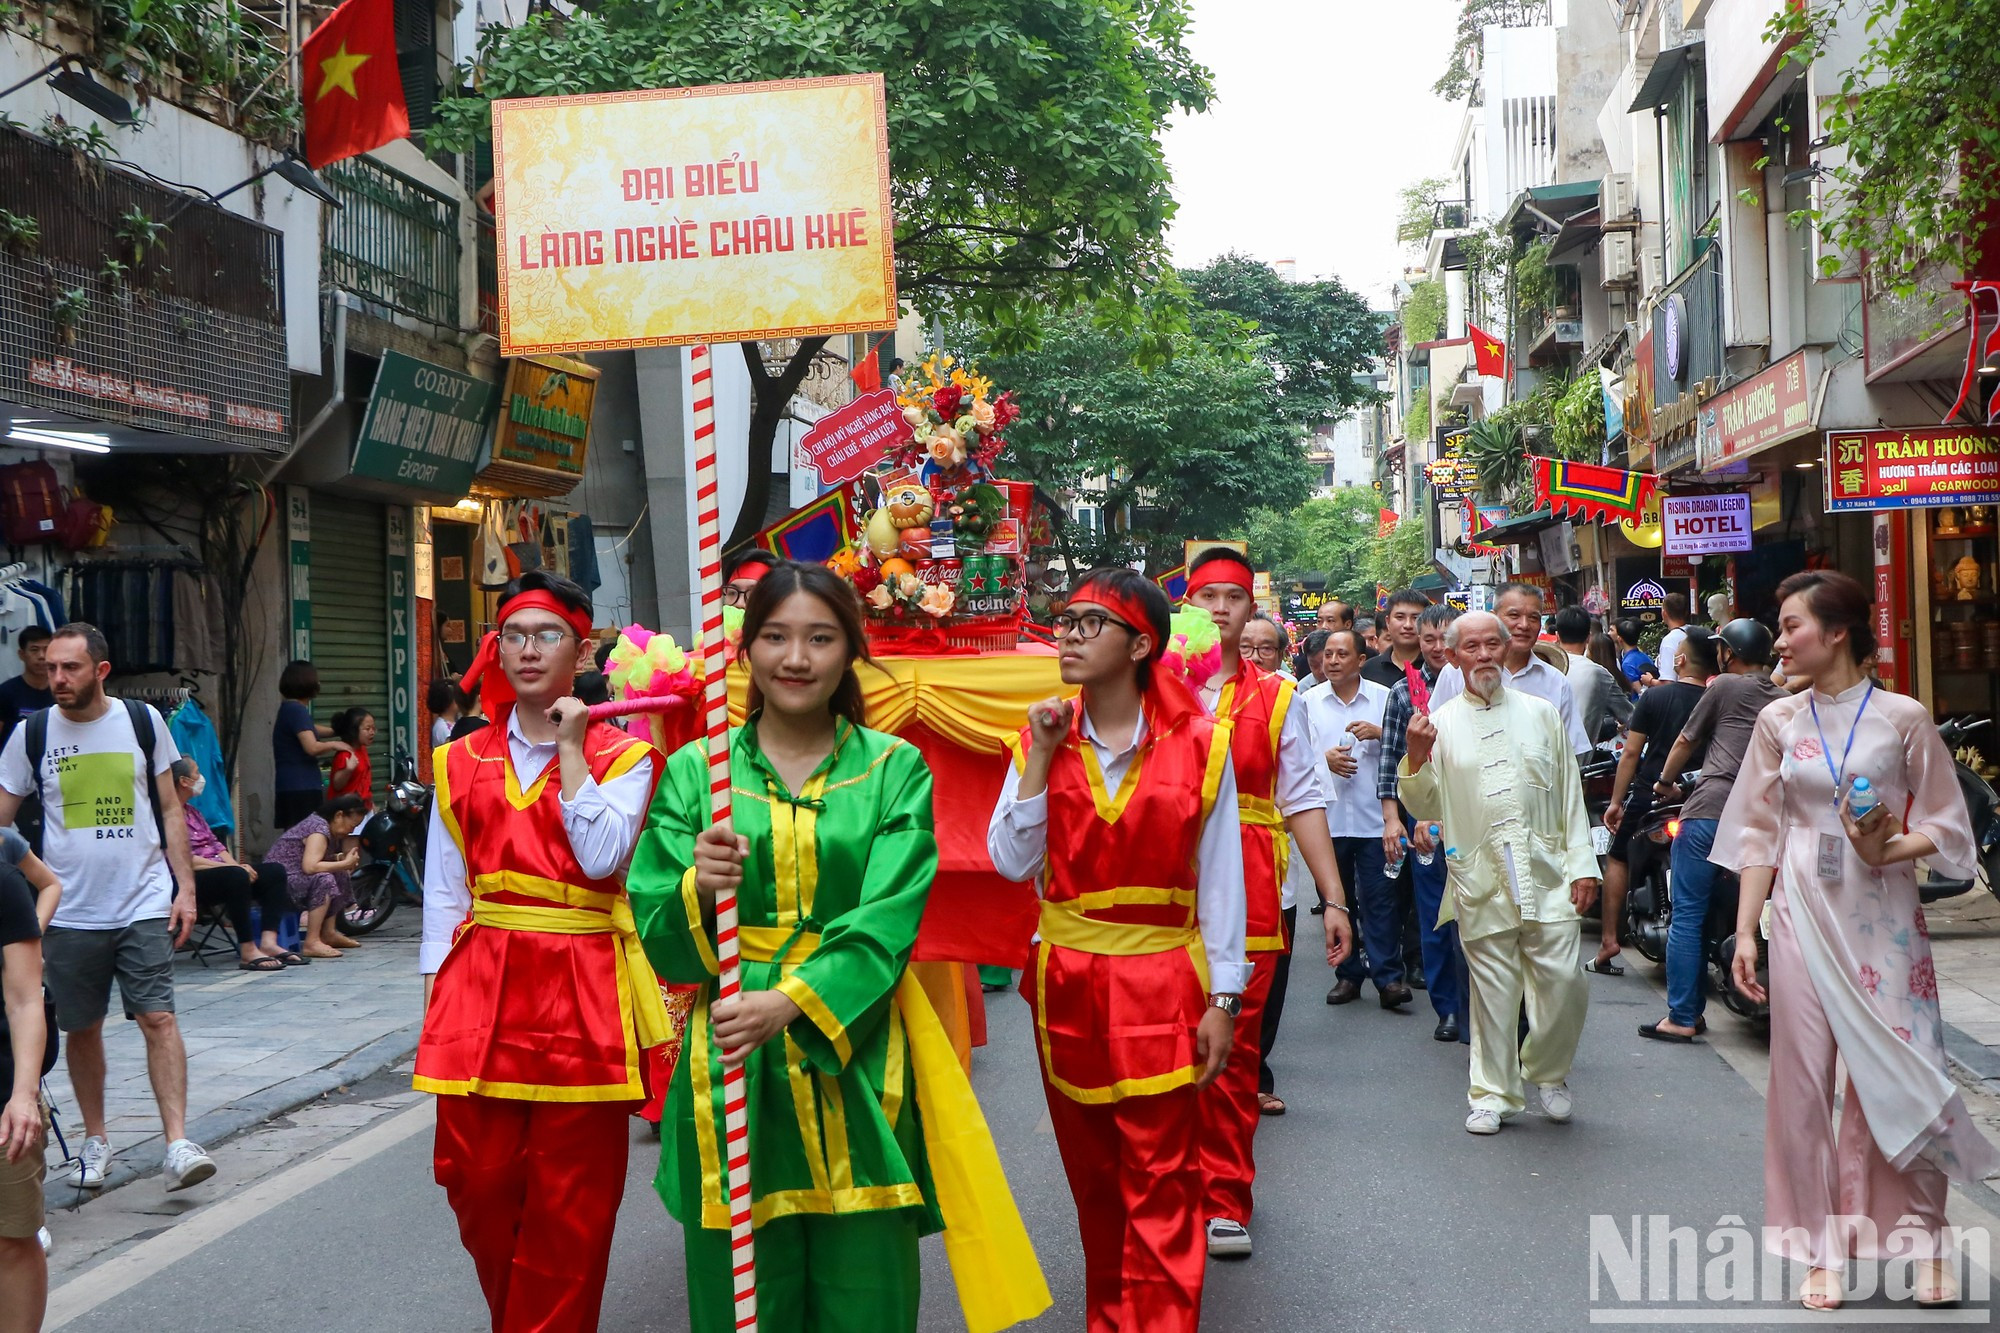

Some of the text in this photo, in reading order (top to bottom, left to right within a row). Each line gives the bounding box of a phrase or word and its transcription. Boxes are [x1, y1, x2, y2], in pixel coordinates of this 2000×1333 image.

[621, 152, 759, 206] ĐẠI BIỂU
[520, 207, 868, 270] LÀNG NGHỀ CHÂU KHÊ
[56, 359, 74, 388] 56
[414, 367, 472, 402] CORNY
[369, 389, 408, 446] HÀNG
[811, 440, 826, 456] CHI
[879, 400, 895, 417] BẠC
[1874, 433, 1929, 460] TRẦM
[397, 459, 439, 483] EXPORT
[1432, 467, 1454, 475] FOOT
[1838, 439, 1866, 495] 沉香
[1879, 460, 1998, 479] HƯƠNG TRẦM CÁC LOẠI
[1431, 475, 1454, 484] BODY
[1929, 479, 1998, 492] AGARWOOD
[1668, 497, 1746, 515] RISING DRAGON LEGEND
[1910, 497, 1927, 505] 0948
[1674, 515, 1743, 535] HOTEL
[1302, 592, 1321, 610] Coffee
[1649, 598, 1664, 606] BEL
[391, 570, 408, 754] EXPOR
[47, 744, 79, 758] LET'S
[47, 756, 69, 766] RUN
[49, 763, 78, 775] AWAY
[95, 796, 122, 806] AND
[95, 807, 134, 817] NEVER
[96, 816, 126, 825] LOOK
[96, 828, 134, 840] BACK
